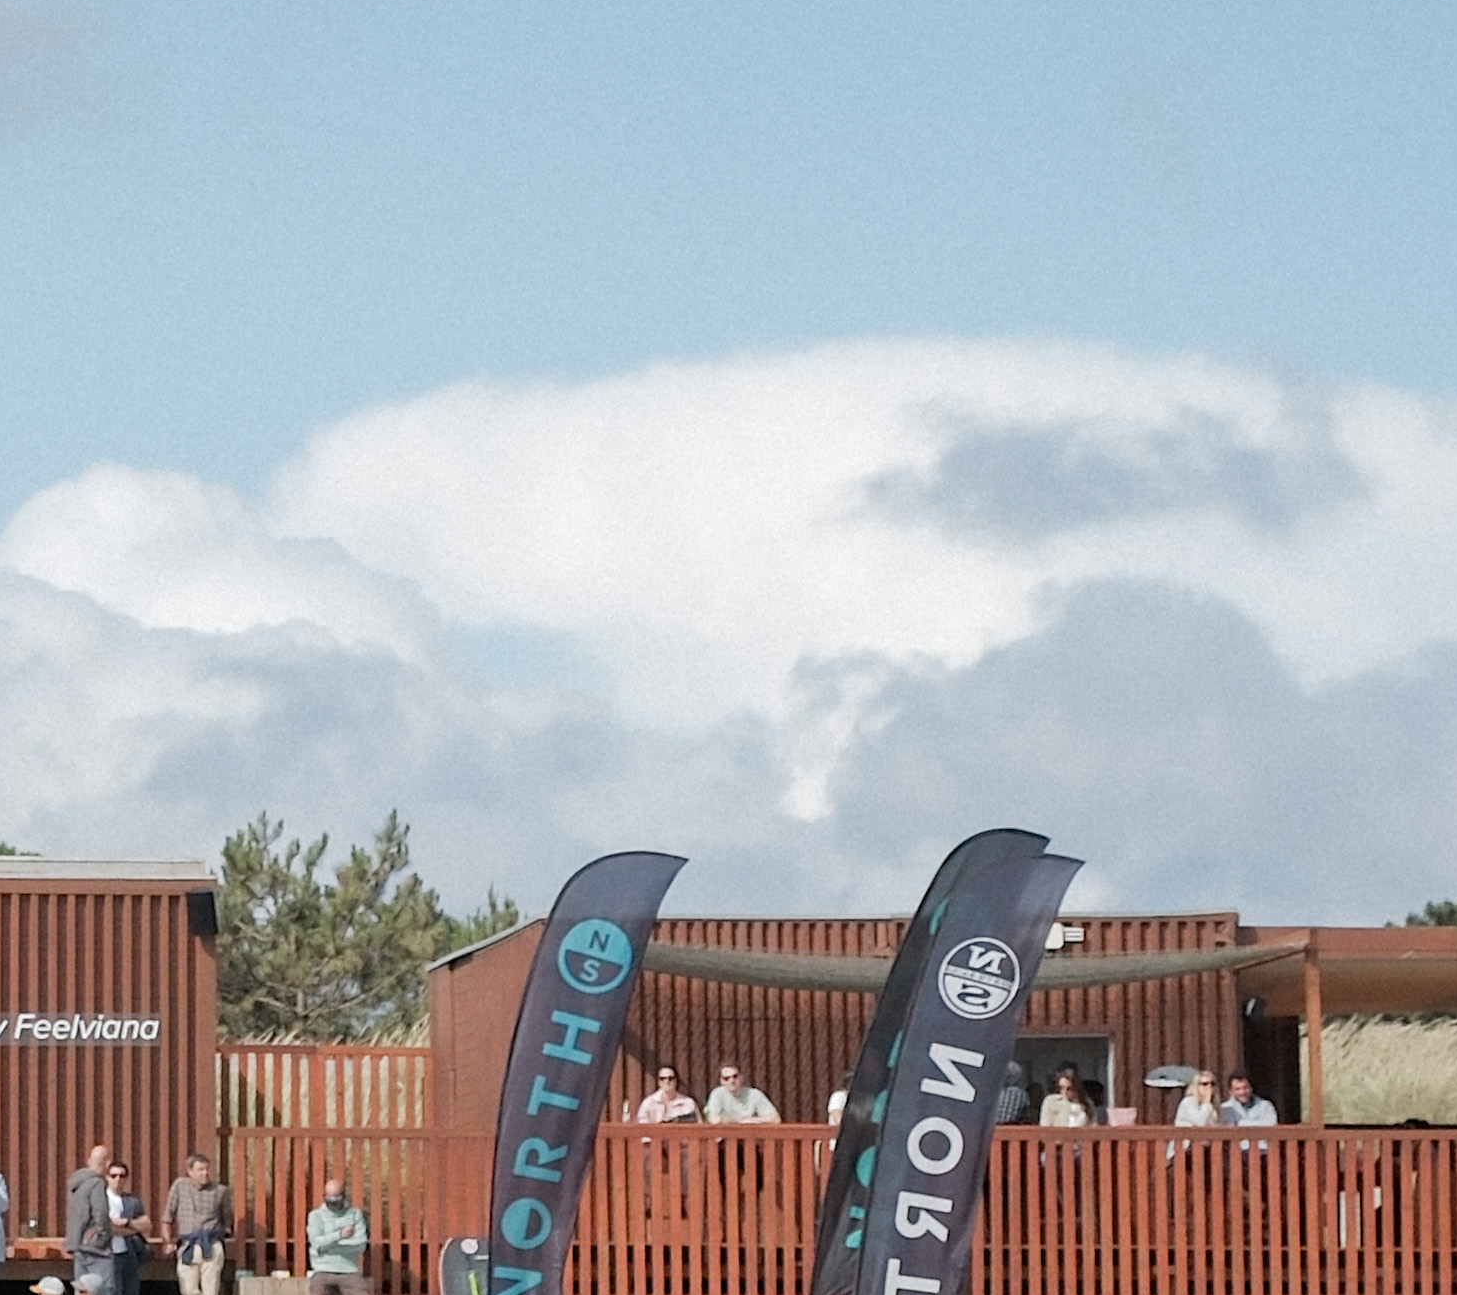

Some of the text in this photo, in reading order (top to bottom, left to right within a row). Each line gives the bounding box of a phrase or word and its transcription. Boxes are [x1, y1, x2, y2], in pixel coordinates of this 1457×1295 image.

[589, 930, 610, 952] N
[580, 960, 601, 982] S
[13, 1012, 160, 1041] Feelviana
